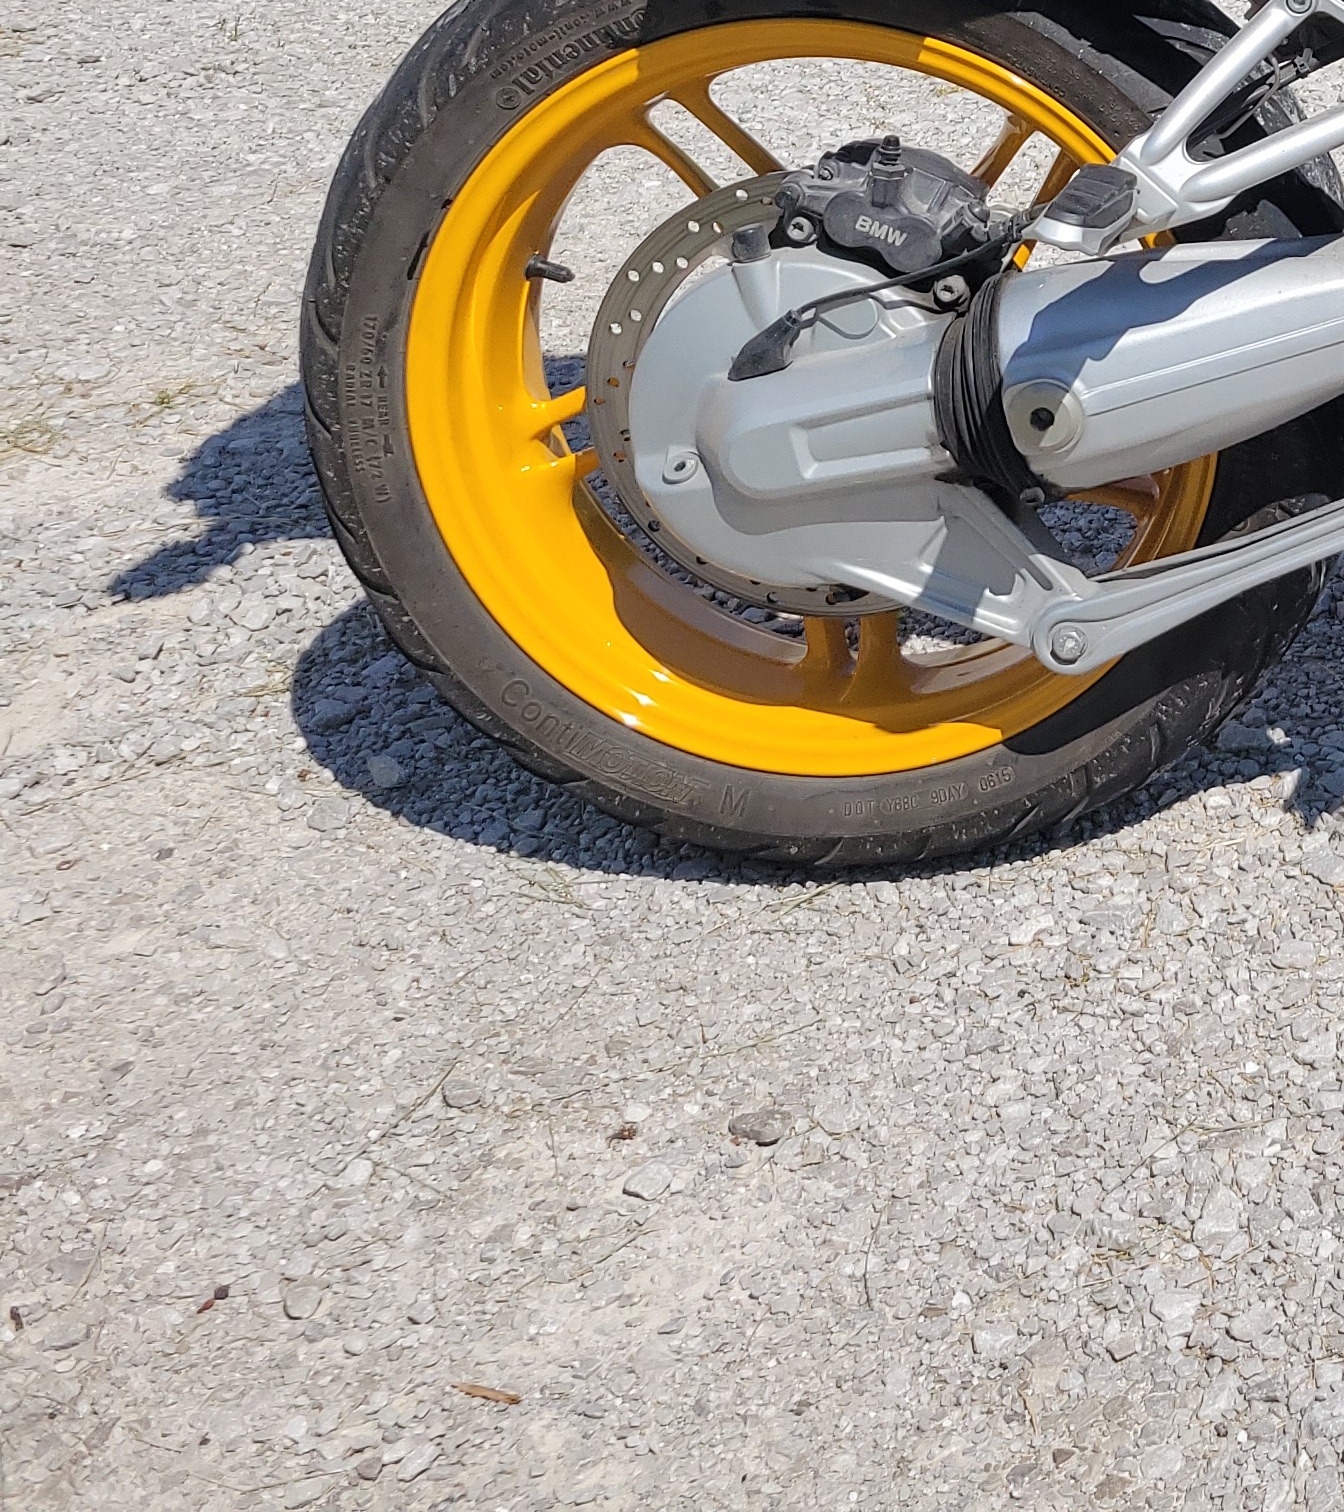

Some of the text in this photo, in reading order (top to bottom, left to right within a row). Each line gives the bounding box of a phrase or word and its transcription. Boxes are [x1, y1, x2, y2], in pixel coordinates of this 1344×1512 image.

[511, 5, 649, 96] ontinental
[855, 214, 908, 246] BMW
[359, 315, 379, 365] 170/60
[843, 799, 876, 817] DOT
[978, 766, 1013, 792] 0615
